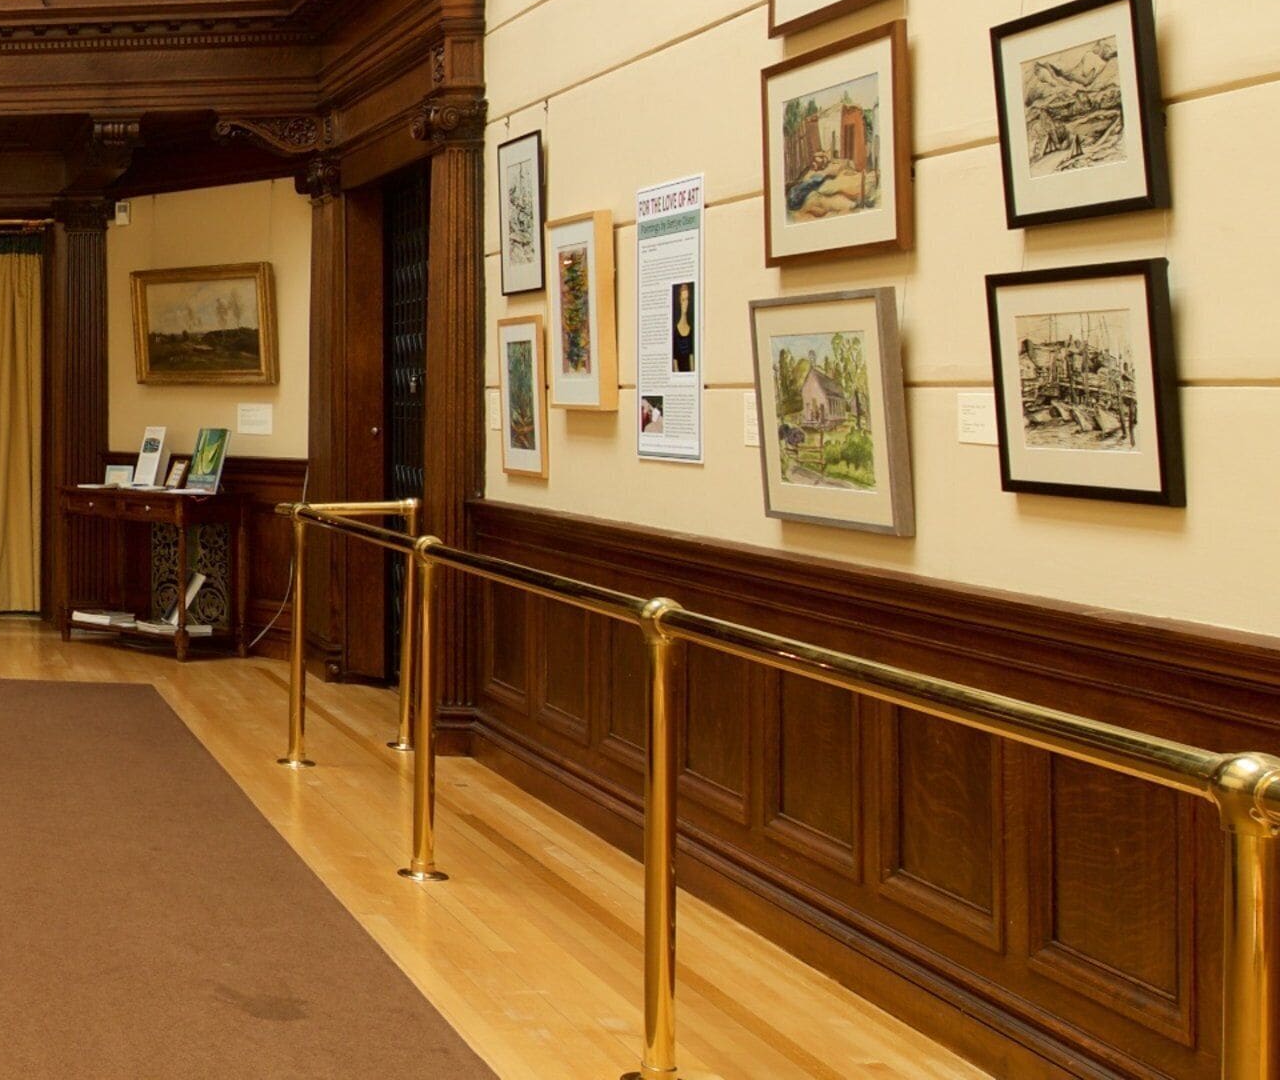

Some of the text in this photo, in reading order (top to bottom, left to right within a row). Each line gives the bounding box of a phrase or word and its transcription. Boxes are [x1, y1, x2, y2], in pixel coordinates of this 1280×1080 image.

[639, 187, 699, 217] FOR THE LOVE OF ART
